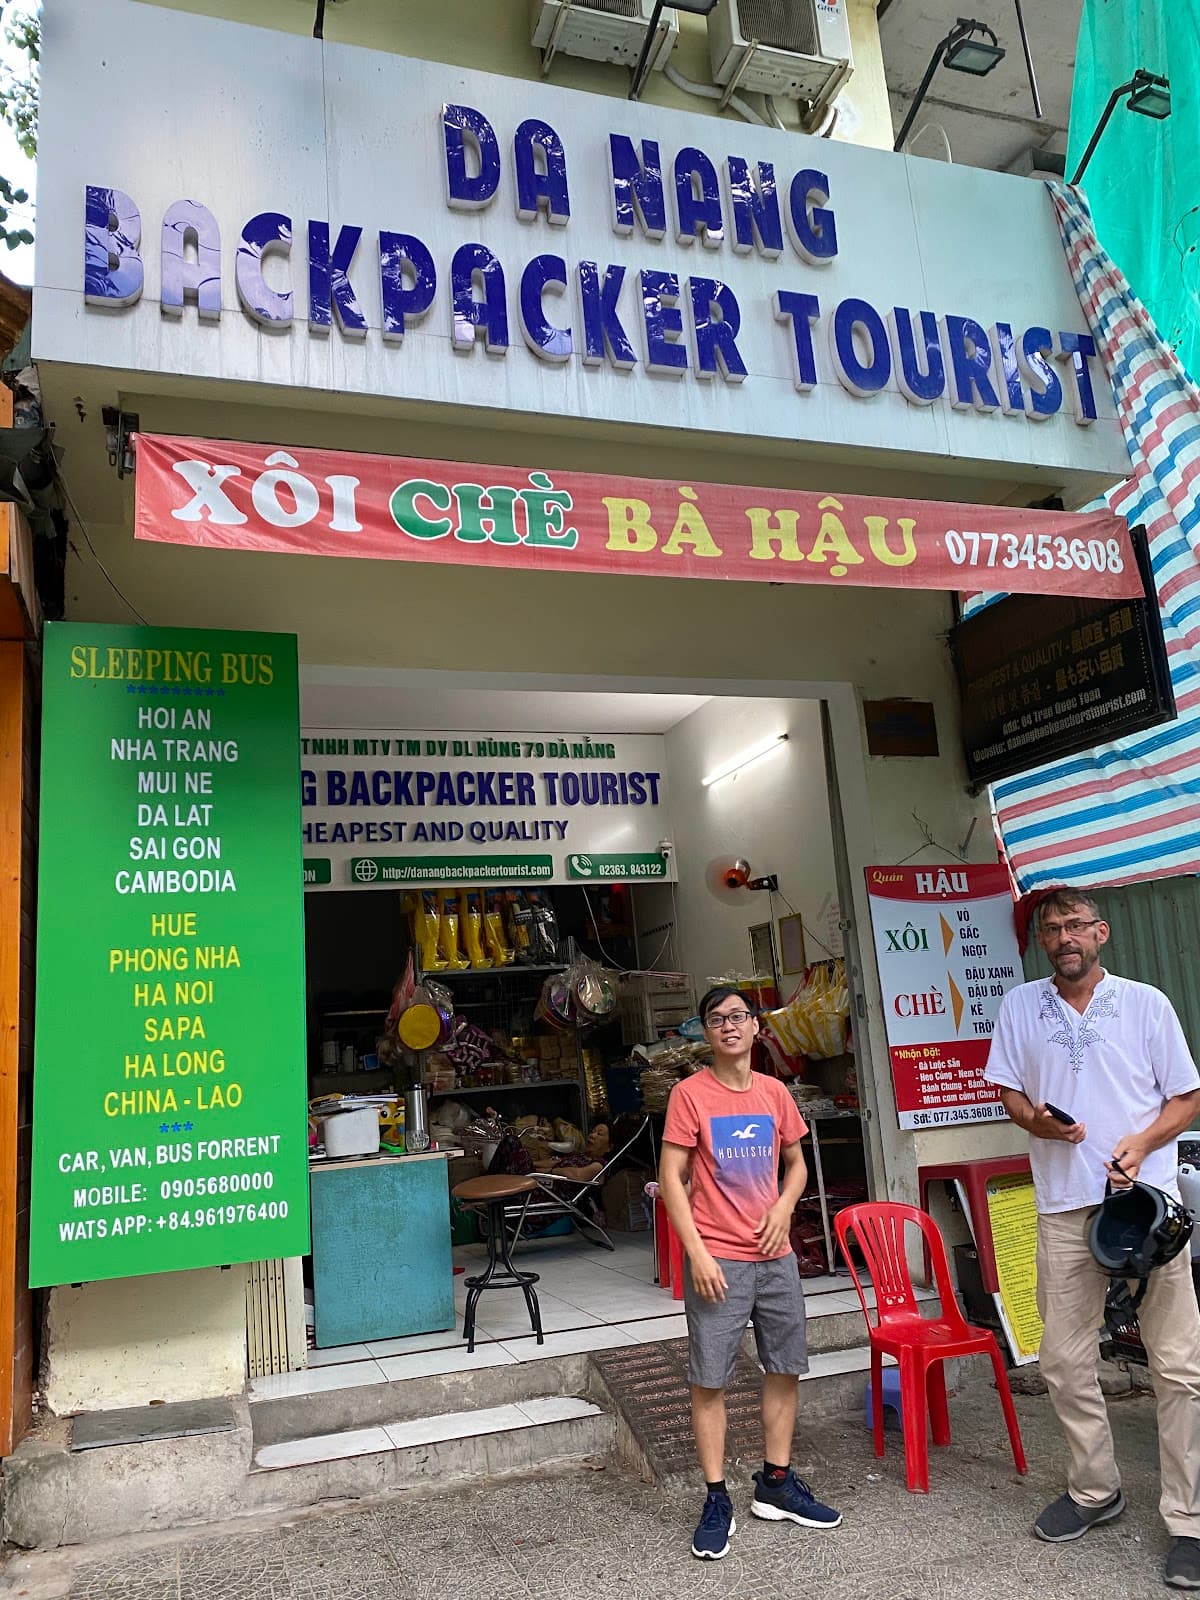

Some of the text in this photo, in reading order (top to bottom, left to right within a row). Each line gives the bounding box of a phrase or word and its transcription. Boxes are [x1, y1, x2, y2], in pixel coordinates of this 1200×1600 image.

[441, 103, 839, 265] DA NANG
[85, 185, 1097, 426] BACKPACKER TOURIST
[172, 451, 1124, 577] XÔI CHÈ BÀ HẬU 0773453608
[69, 645, 274, 685] SLEEPING BUS
[138, 707, 211, 730] HOI AN
[111, 739, 239, 762] NHA TRANG
[301, 738, 349, 756] TNHH
[353, 739, 391, 756] MTV
[395, 739, 421, 756] TM
[425, 740, 448, 757] DV
[452, 740, 473, 757] DL
[525, 741, 545, 758] 79
[138, 772, 213, 794] MUI NE
[327, 770, 537, 806] BACKPACKER
[543, 771, 661, 806] TOURIST
[138, 804, 213, 826] DA LAT
[413, 821, 464, 842] AND
[469, 820, 569, 843] QUALITY
[129, 837, 221, 860] SAI GON
[115, 870, 237, 894] CAMBODIA
[382, 864, 551, 880] http://danangbackpackertourist.com
[630, 863, 662, 875] 843122
[915, 868, 970, 898] HẬU
[151, 912, 197, 937] HUE
[885, 921, 930, 952] XÔI
[109, 945, 241, 973] PHONG NHA
[962, 944, 988, 959] NGỌT
[988, 966, 1015, 979] XANH
[134, 981, 214, 1007] HA NOI
[894, 985, 946, 1017] CHÈ
[144, 1016, 207, 1042] SAPA
[125, 1049, 226, 1079] HA LONG
[104, 1088, 178, 1117] CHINA
[197, 1083, 243, 1111] LAO
[933, 1106, 993, 1123] 077.345.3608
[58, 1151, 106, 1174] CAR,
[109, 1147, 152, 1169] VAN,
[156, 1143, 193, 1165] BUS
[718, 1145, 773, 1159] HOLLISTER
[73, 1171, 274, 1208] MOBILE: 0905680000
[59, 1200, 289, 1242] WATS APP: +84.961976400
